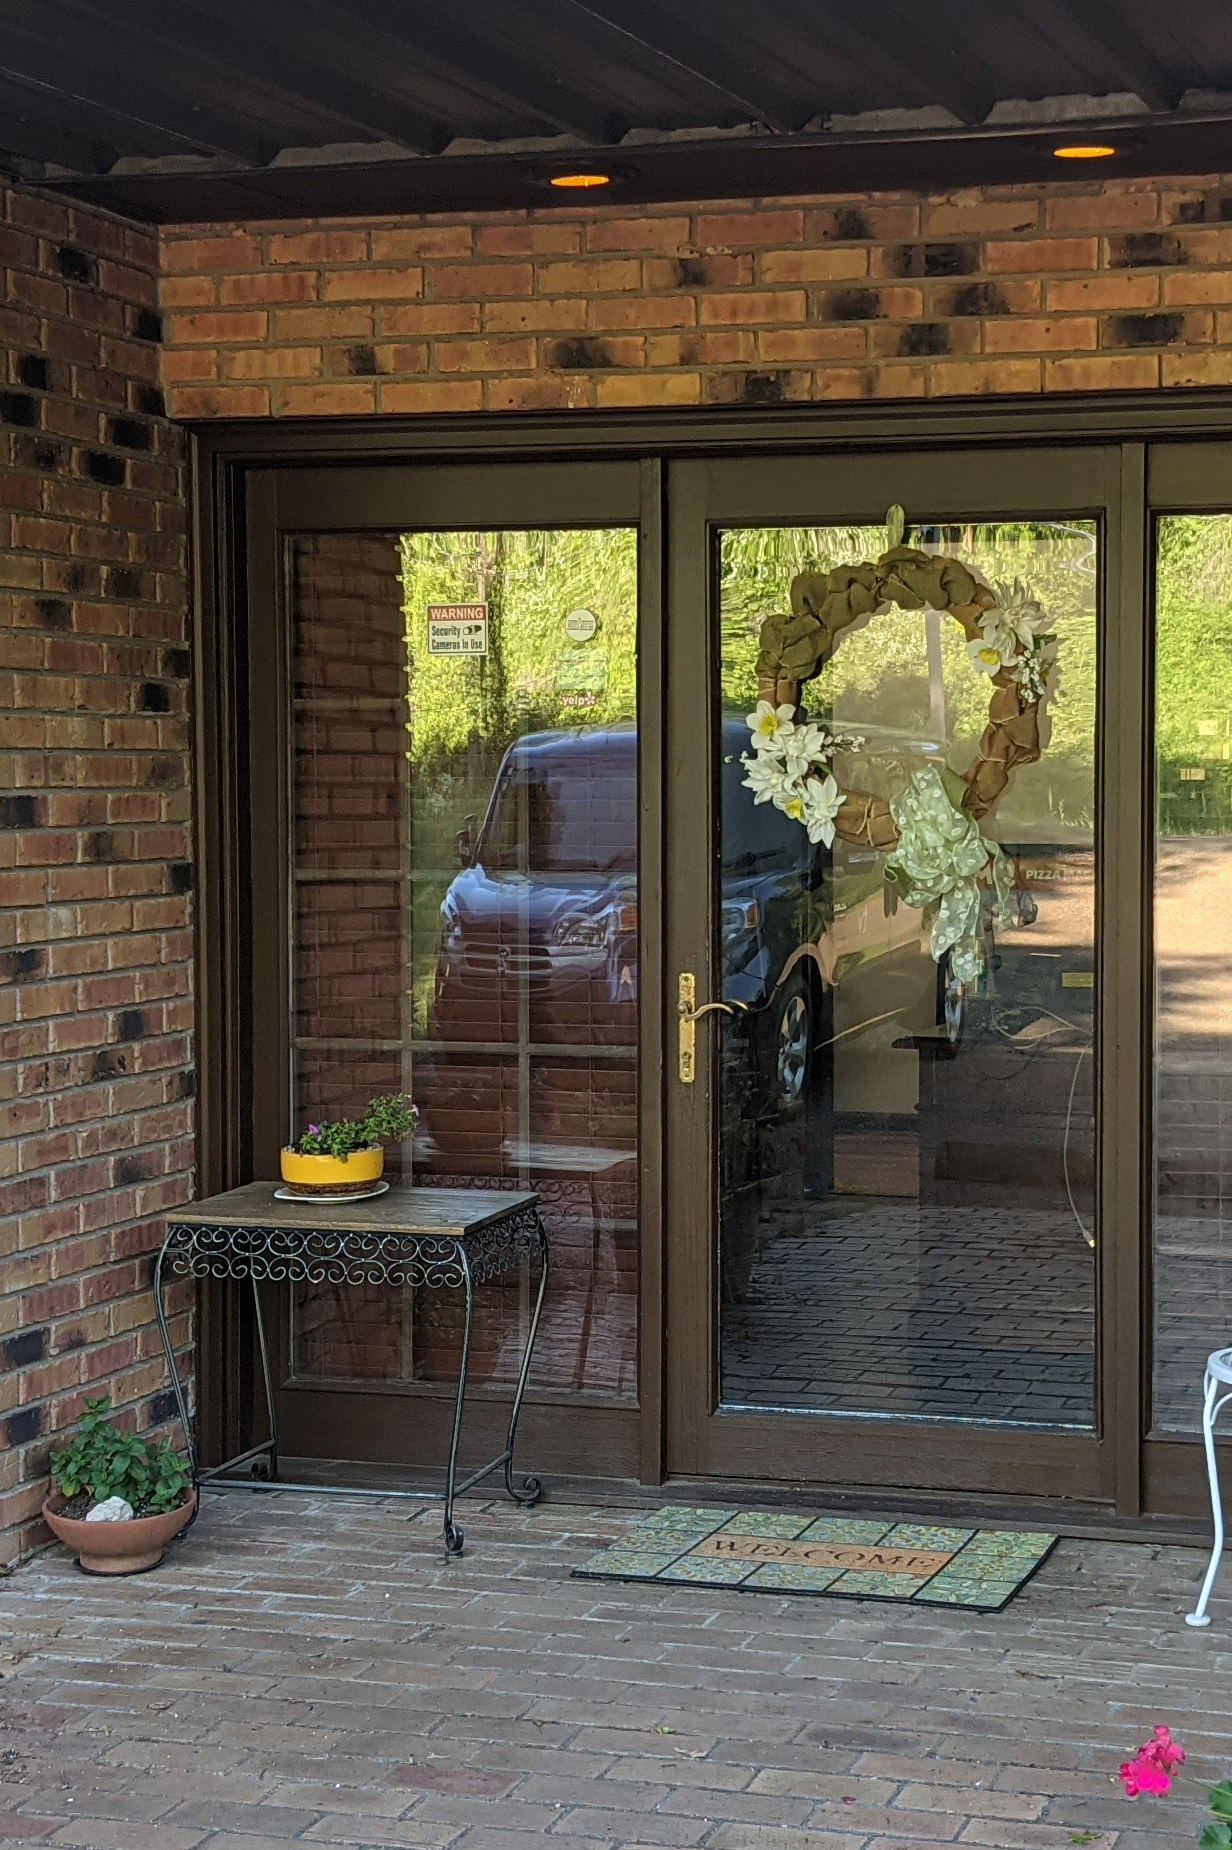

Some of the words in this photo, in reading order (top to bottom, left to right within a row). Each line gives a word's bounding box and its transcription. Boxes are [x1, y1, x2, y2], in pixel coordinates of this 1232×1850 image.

[430, 607, 484, 620] WARNING
[431, 624, 461, 638] Security
[431, 638, 461, 650] Cameras
[462, 638, 469, 650] In
[470, 638, 483, 650] Use
[562, 694, 586, 707] yelp
[1025, 870, 1061, 880] PIZZA
[713, 1539, 936, 1569] WELCOME
